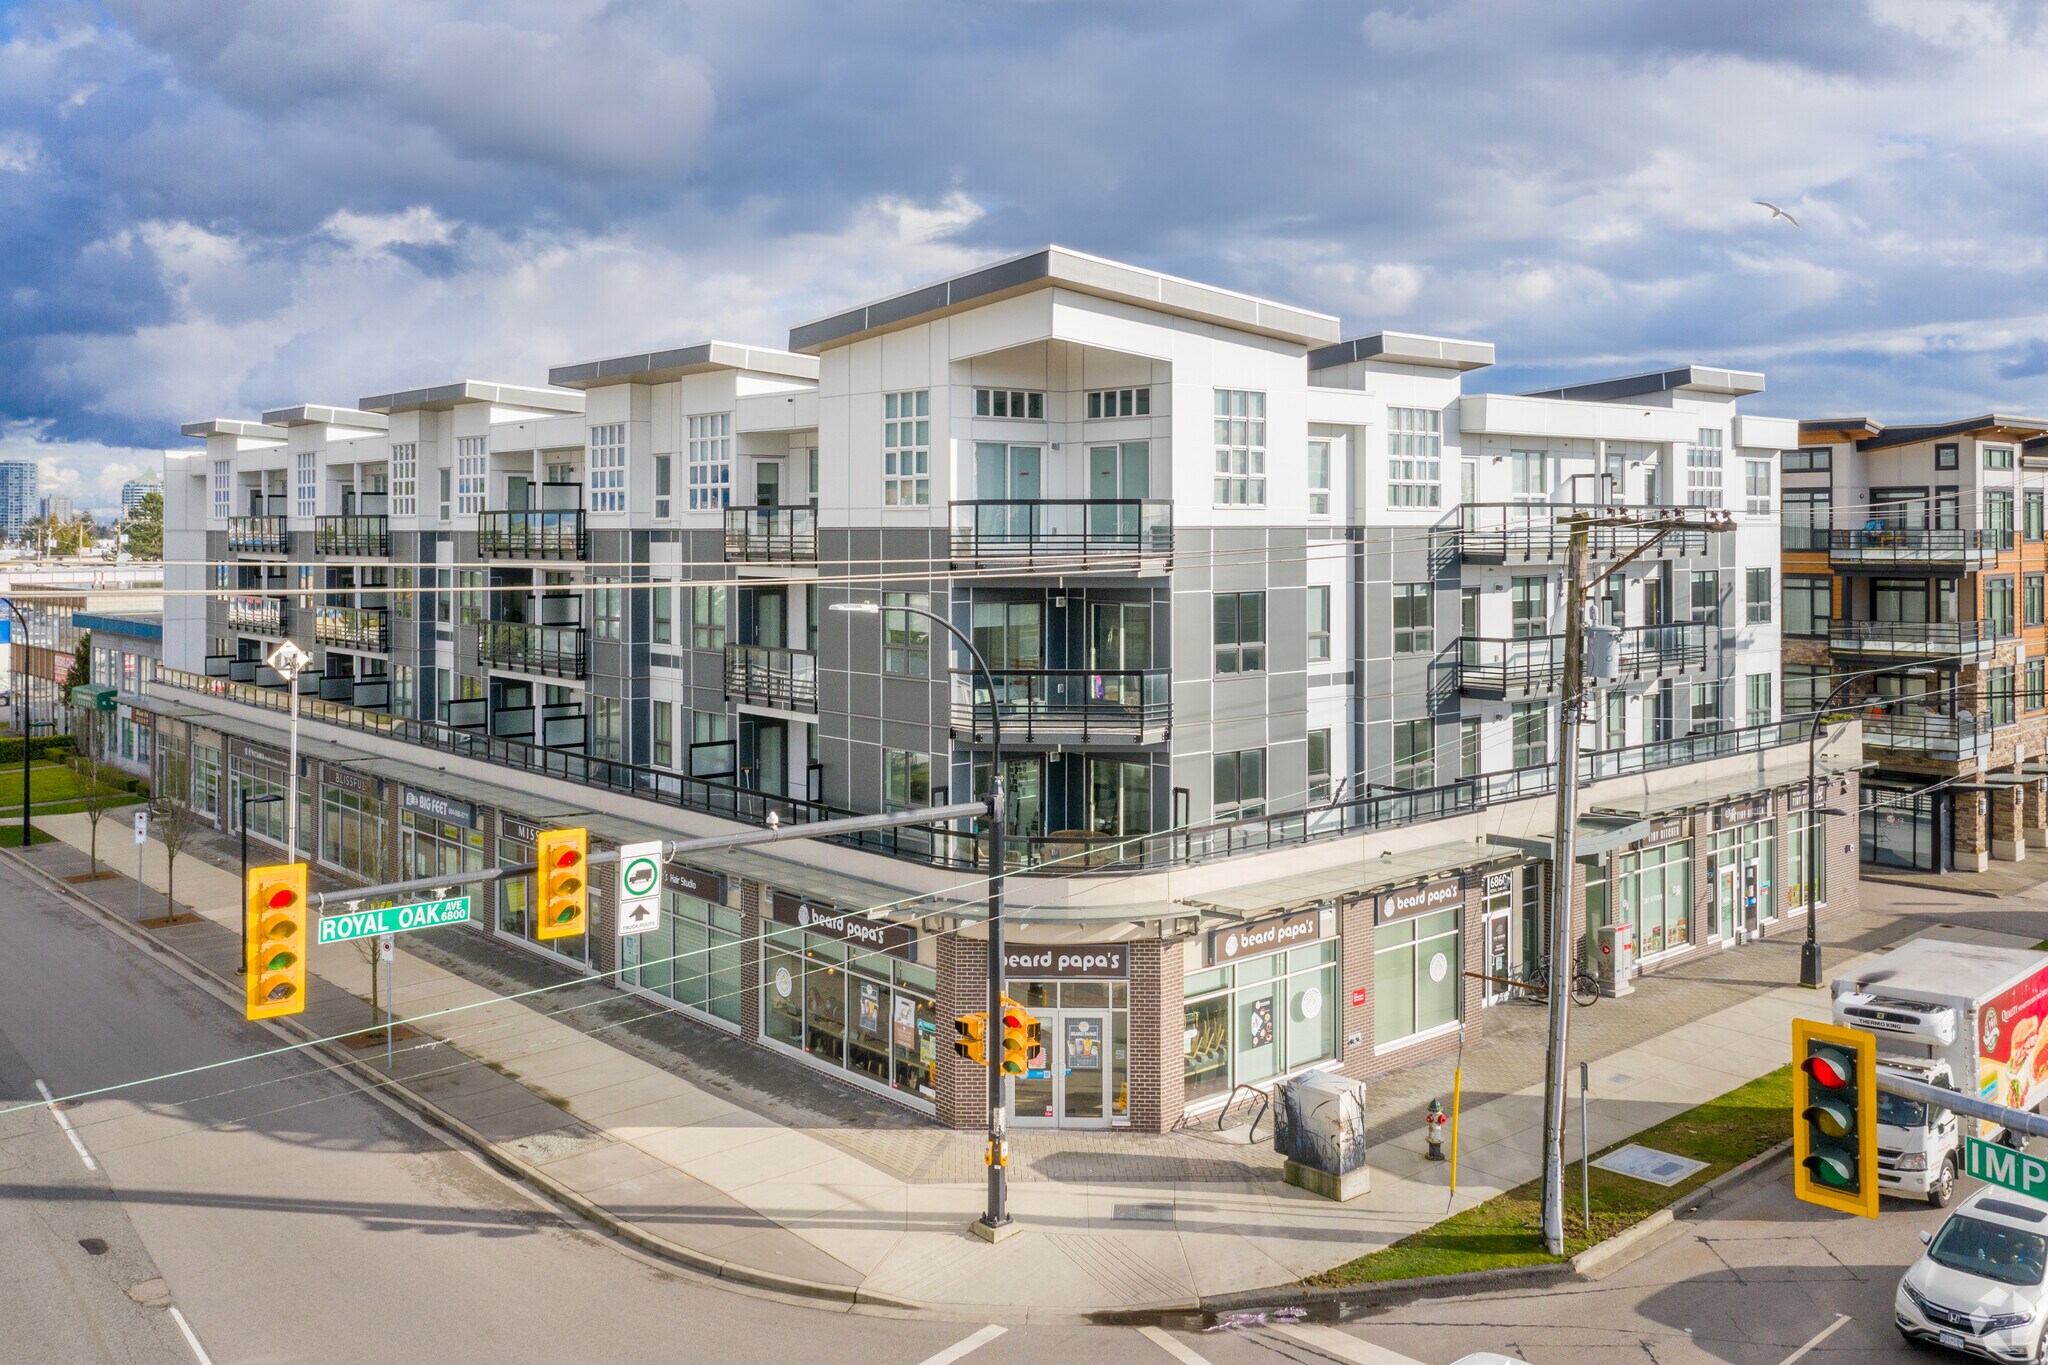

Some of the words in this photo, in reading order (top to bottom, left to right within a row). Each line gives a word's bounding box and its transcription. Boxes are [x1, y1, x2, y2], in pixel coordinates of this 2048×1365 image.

[335, 772, 366, 791] BLISSFUL
[419, 795, 431, 811] BIG
[431, 799, 448, 816] FEET
[670, 873, 680, 885] Hair
[681, 876, 697, 889] Studio
[445, 900, 463, 912] AVE
[1397, 891, 1425, 910] beard
[1427, 884, 1457, 906] papa's
[322, 912, 389, 940] ROYAL
[398, 903, 440, 929] OAK
[440, 908, 466, 922] 6800
[622, 923, 639, 931] TRUCK
[639, 920, 656, 928] ROUTE
[811, 908, 844, 932] beard
[847, 921, 884, 944] papa's
[1241, 926, 1275, 948] beard
[1277, 919, 1314, 943] papa's
[1058, 952, 1120, 971] papa's
[1859, 1018, 1886, 1028] THERMO
[1886, 1022, 1902, 1030] KING
[1971, 1142, 2046, 1191] IMP
